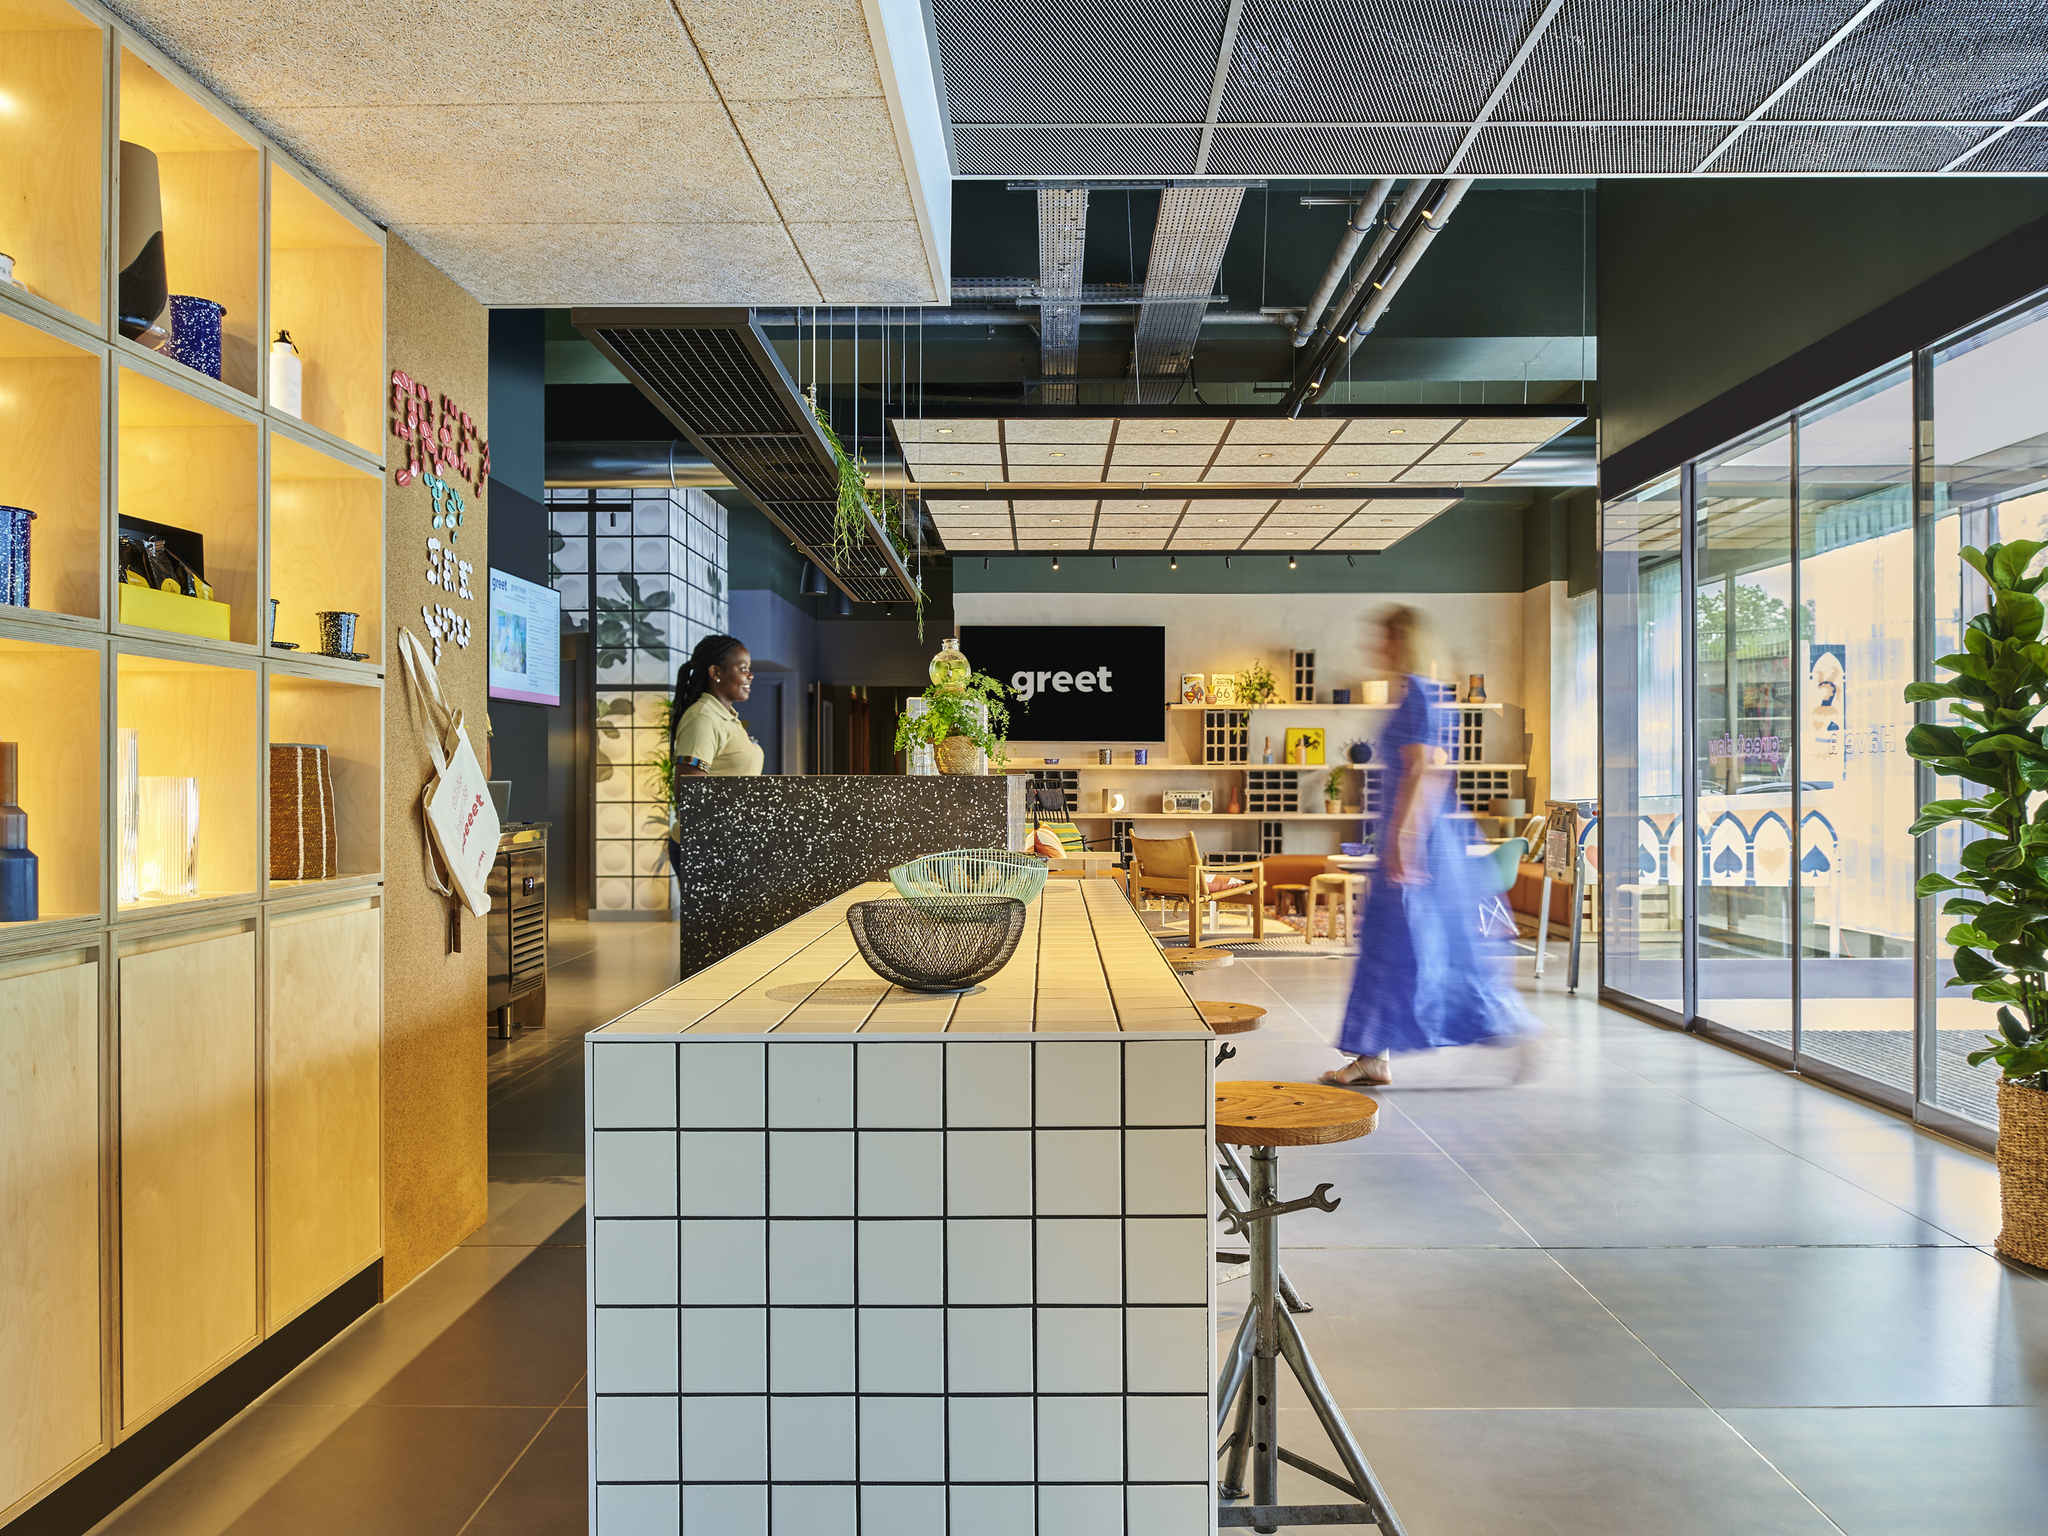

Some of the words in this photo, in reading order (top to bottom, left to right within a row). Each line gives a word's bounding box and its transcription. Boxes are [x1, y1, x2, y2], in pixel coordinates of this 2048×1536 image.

[426, 537, 474, 601] SEE
[422, 603, 471, 666] YOU
[1011, 666, 1113, 702] greet
